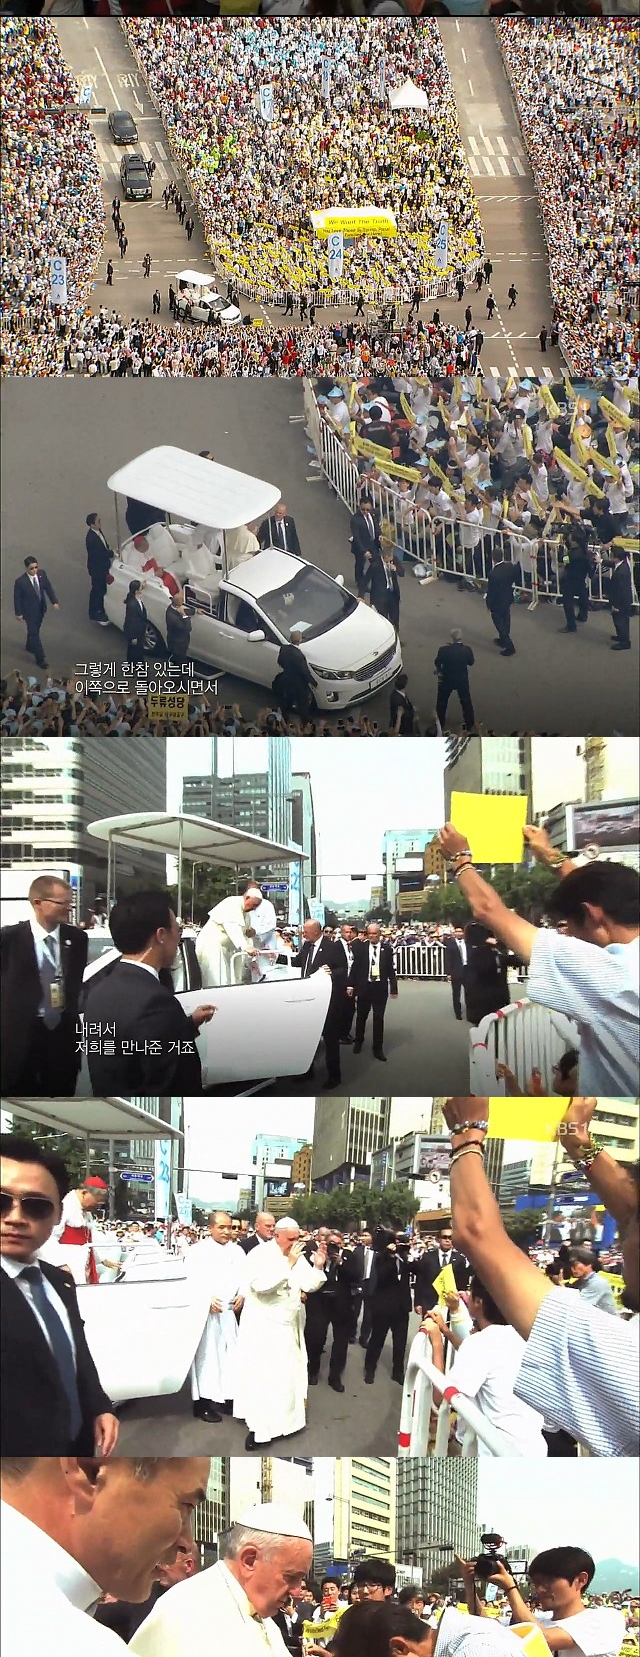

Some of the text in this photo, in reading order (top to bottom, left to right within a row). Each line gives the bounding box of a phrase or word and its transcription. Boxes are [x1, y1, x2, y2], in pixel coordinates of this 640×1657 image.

[331, 235, 340, 246] C
[329, 248, 342, 260] 24
[53, 260, 62, 271] C
[51, 273, 65, 285] 23
[150, 695, 185, 708] 두류성당
